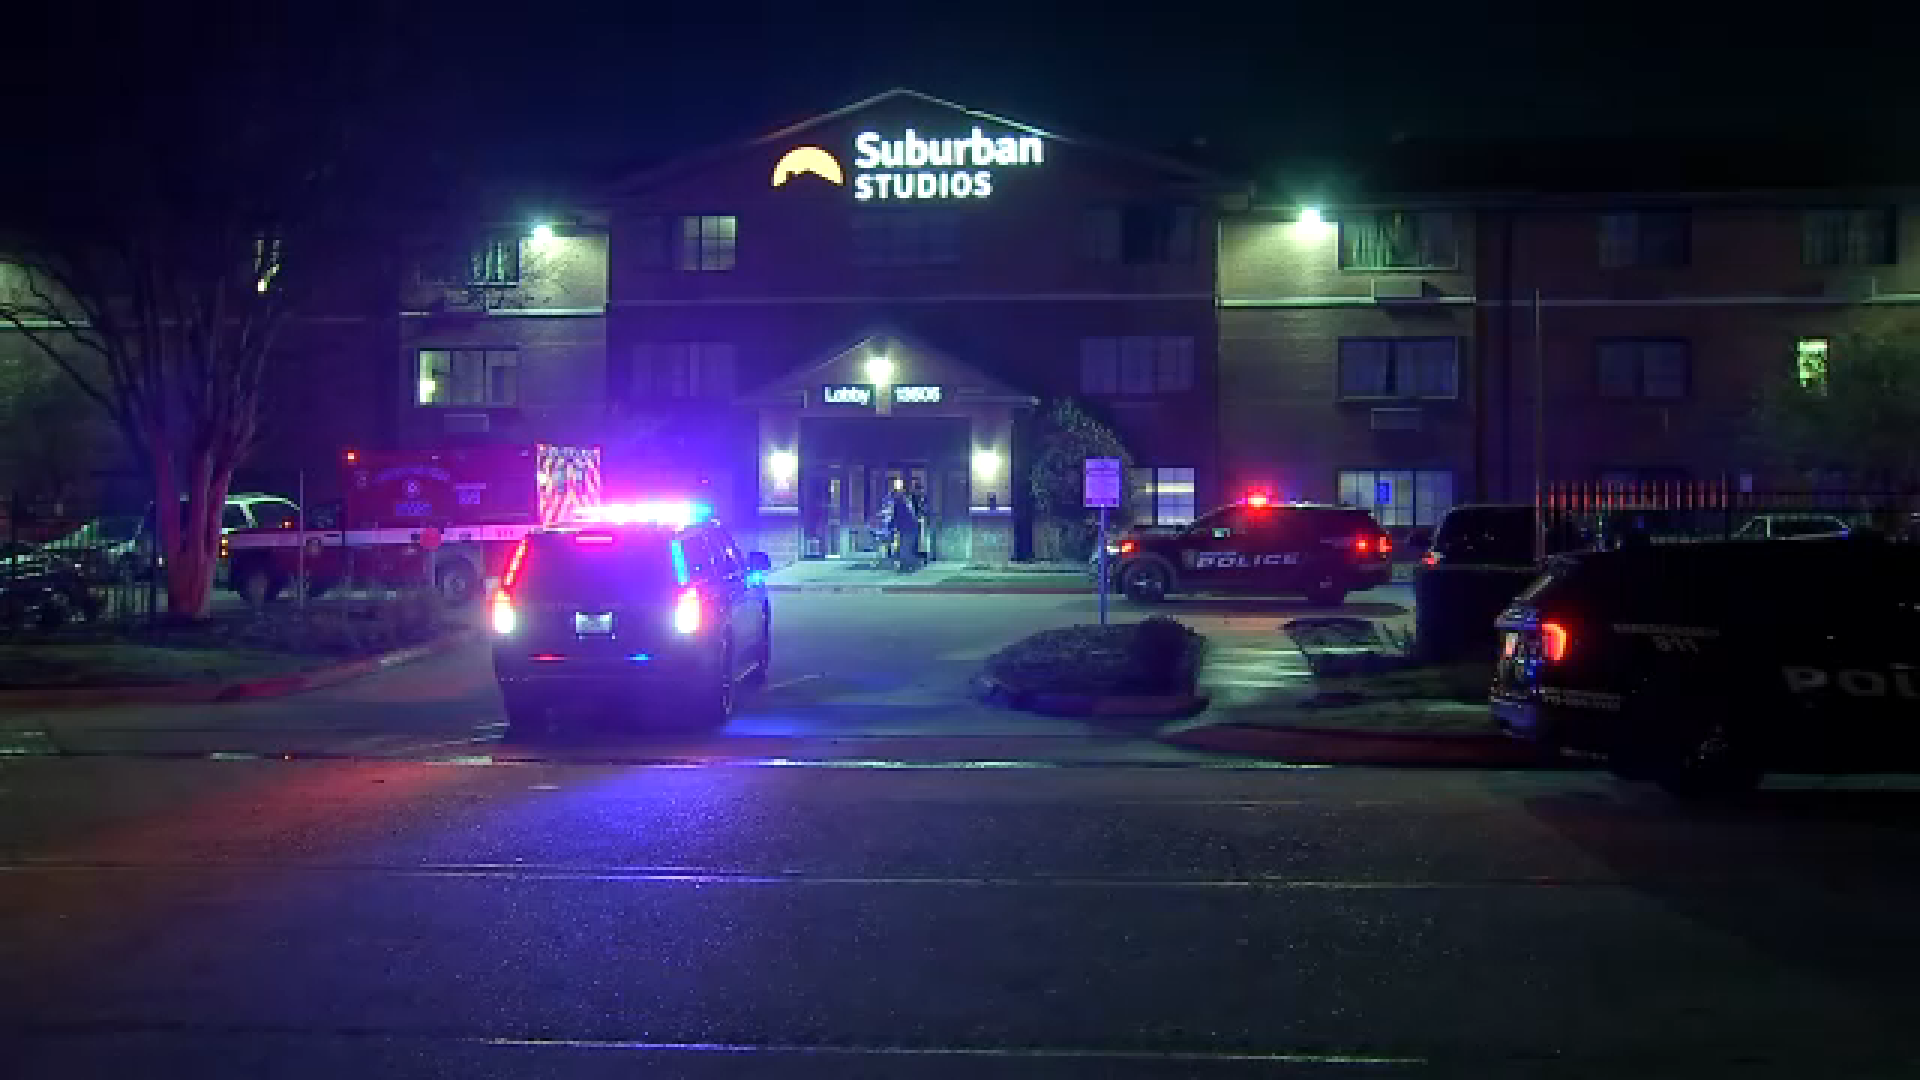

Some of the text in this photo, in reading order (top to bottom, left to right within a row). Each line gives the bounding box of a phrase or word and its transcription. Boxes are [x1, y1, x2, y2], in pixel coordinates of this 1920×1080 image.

[854, 126, 1044, 168] Suburban
[854, 171, 993, 200] STUDIOS
[824, 386, 871, 405] Lobby
[1197, 551, 1299, 568] POLICE
